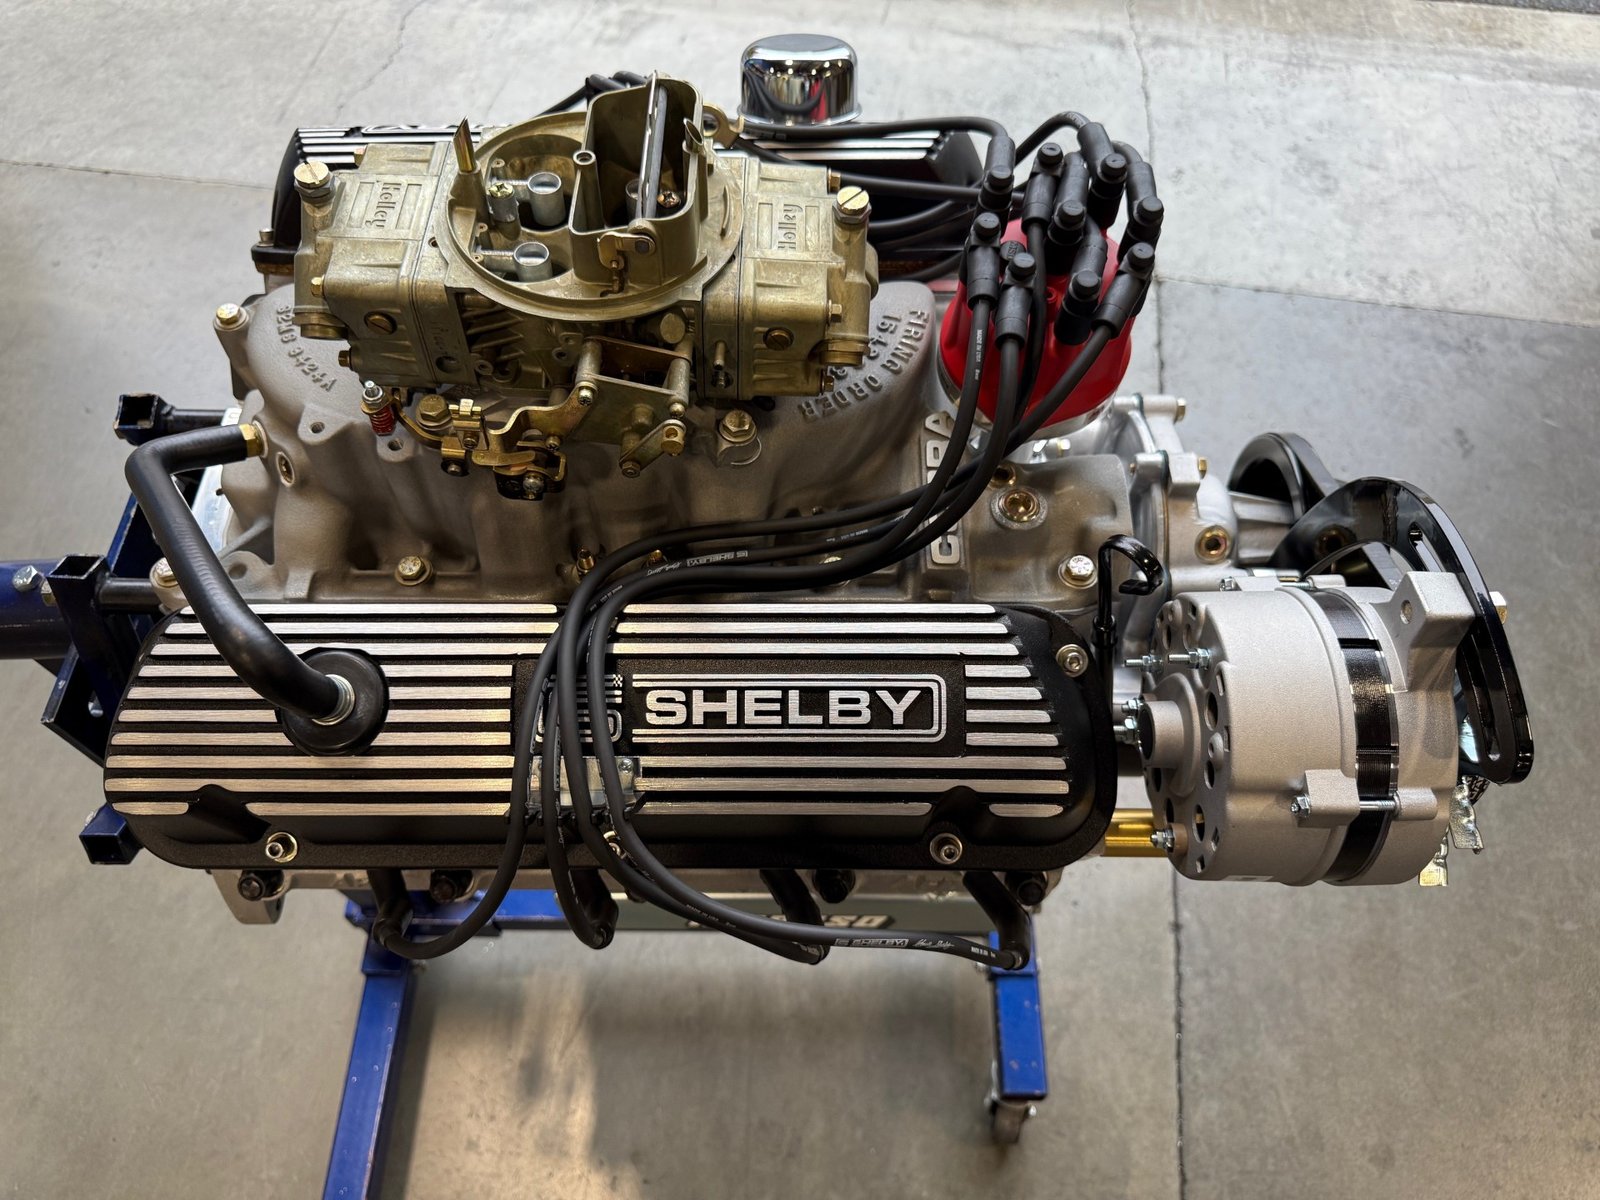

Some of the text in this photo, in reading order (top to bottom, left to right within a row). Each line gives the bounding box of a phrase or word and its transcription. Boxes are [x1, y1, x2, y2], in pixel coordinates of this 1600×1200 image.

[777, 203, 804, 250] Holley
[797, 309, 931, 421] FIRING ORDER
[924, 410, 961, 565] CRA
[645, 689, 922, 726] SHELBY
